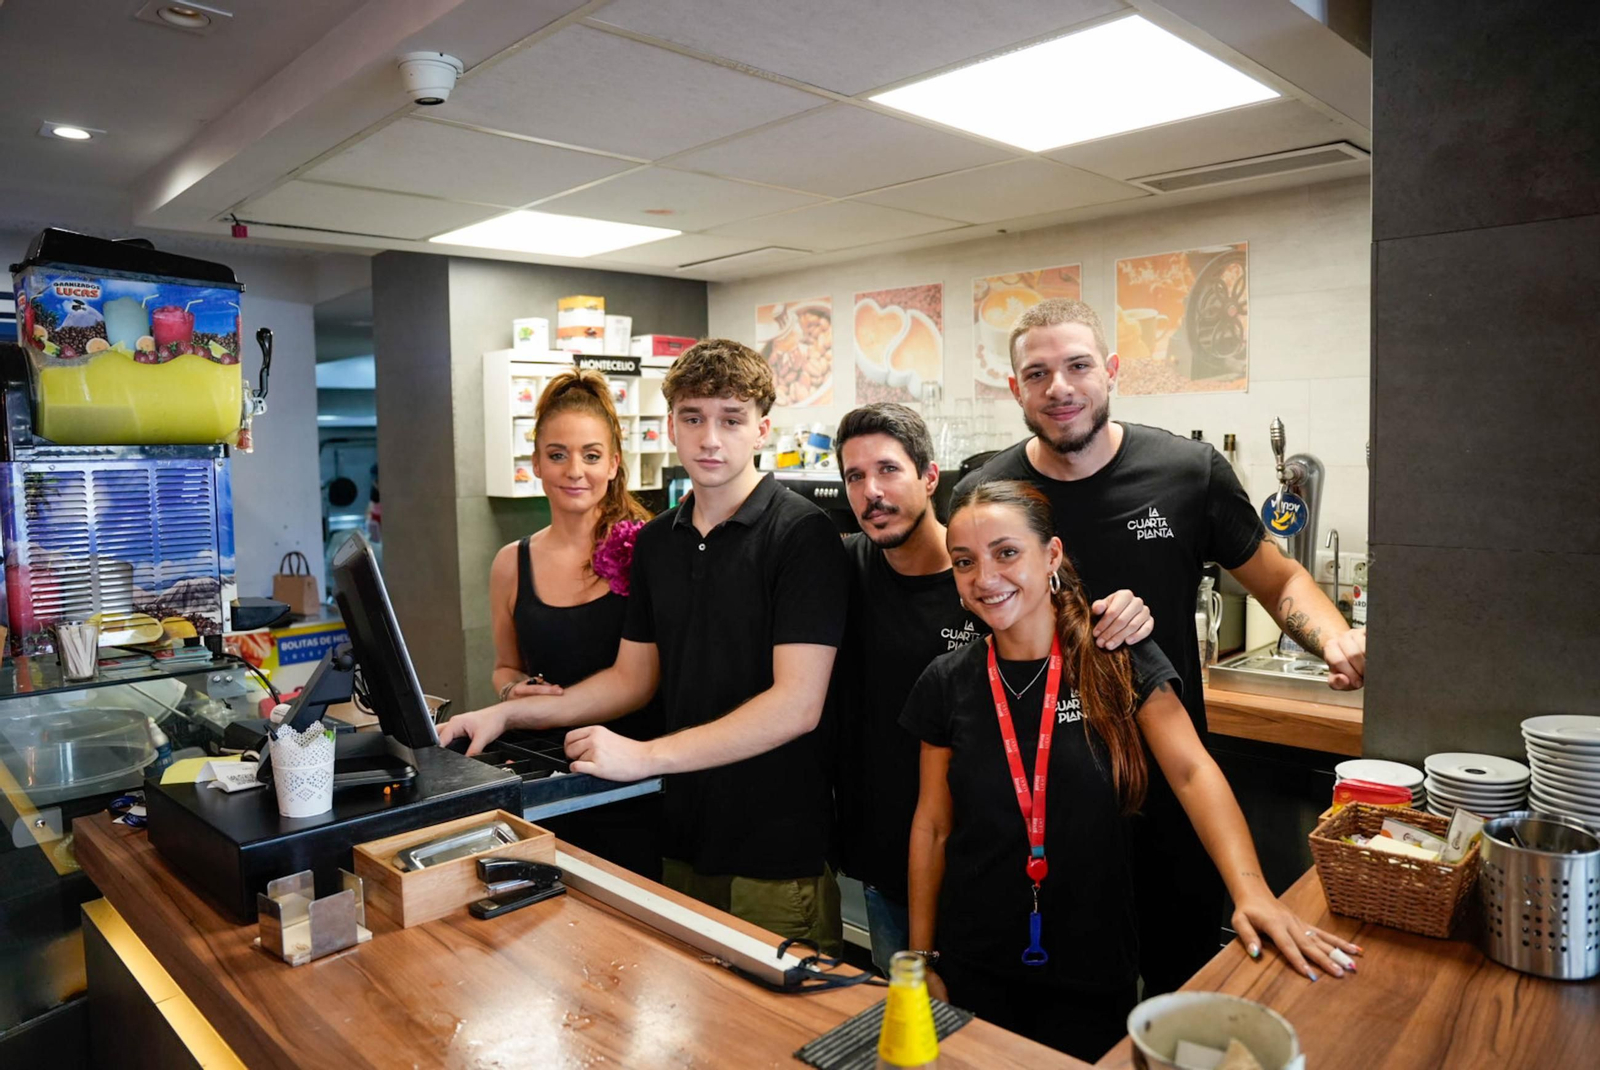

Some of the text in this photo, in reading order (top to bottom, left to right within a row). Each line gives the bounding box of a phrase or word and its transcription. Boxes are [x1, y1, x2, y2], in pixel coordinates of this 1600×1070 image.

[56, 286, 99, 298] LUCAS
[579, 359, 635, 372] MONTECELIO
[1149, 507, 1160, 518] LA
[1127, 517, 1168, 530] CUARTA
[1137, 527, 1175, 541] PLANTA
[963, 620, 975, 631] LA
[940, 627, 981, 642] CUART
[281, 633, 350, 651] BOLITAS DE HEL
[1055, 698, 1081, 712] UAR
[1058, 710, 1088, 724] PLAN
